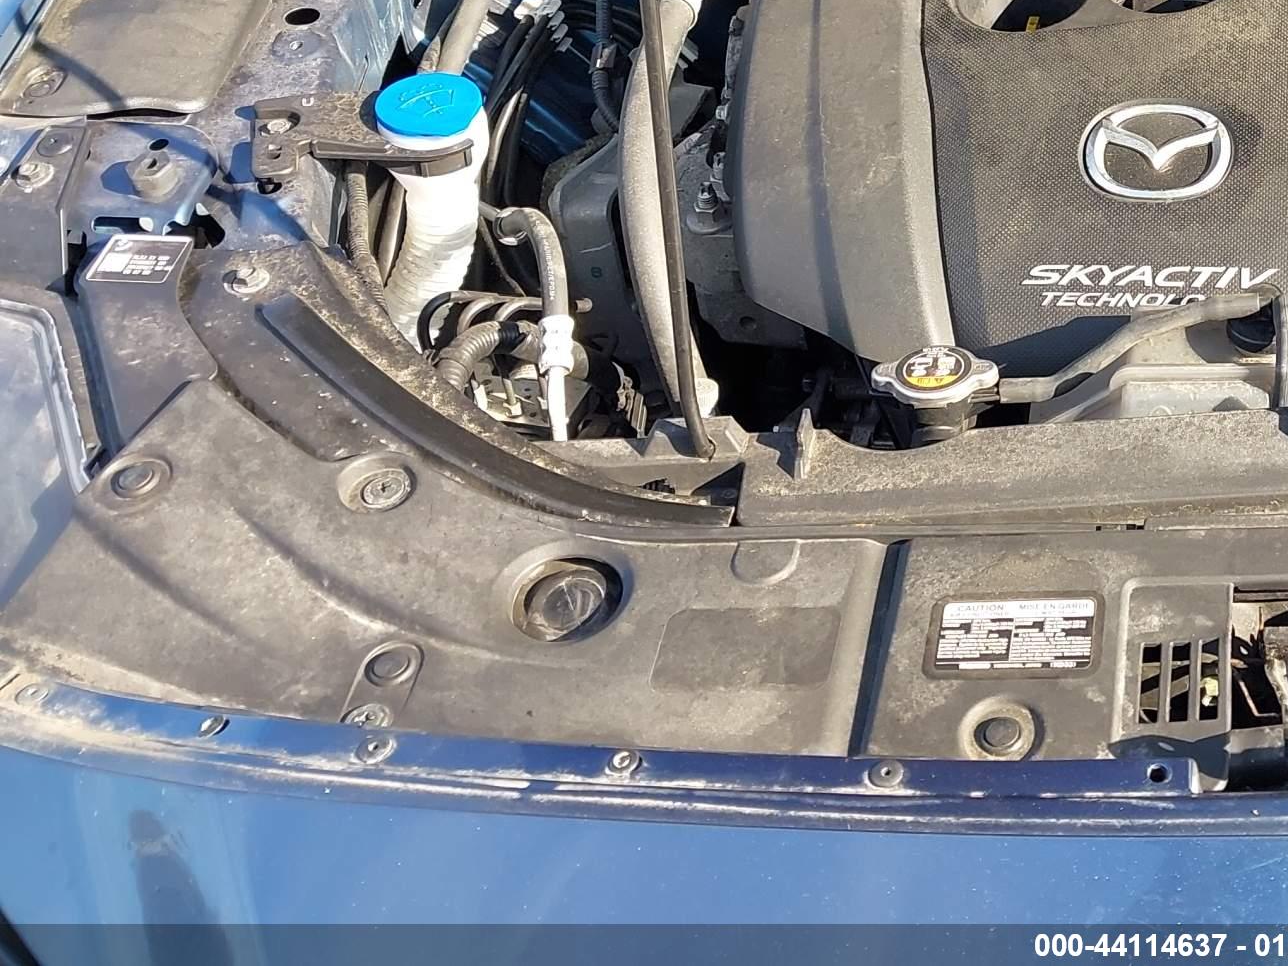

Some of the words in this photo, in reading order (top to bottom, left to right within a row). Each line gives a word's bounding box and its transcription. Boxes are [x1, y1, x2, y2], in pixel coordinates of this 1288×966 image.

[1021, 264, 1280, 289] SKYACTIV
[1040, 292, 1206, 308] TECHNOLO
[957, 604, 1004, 612] CAUTION
